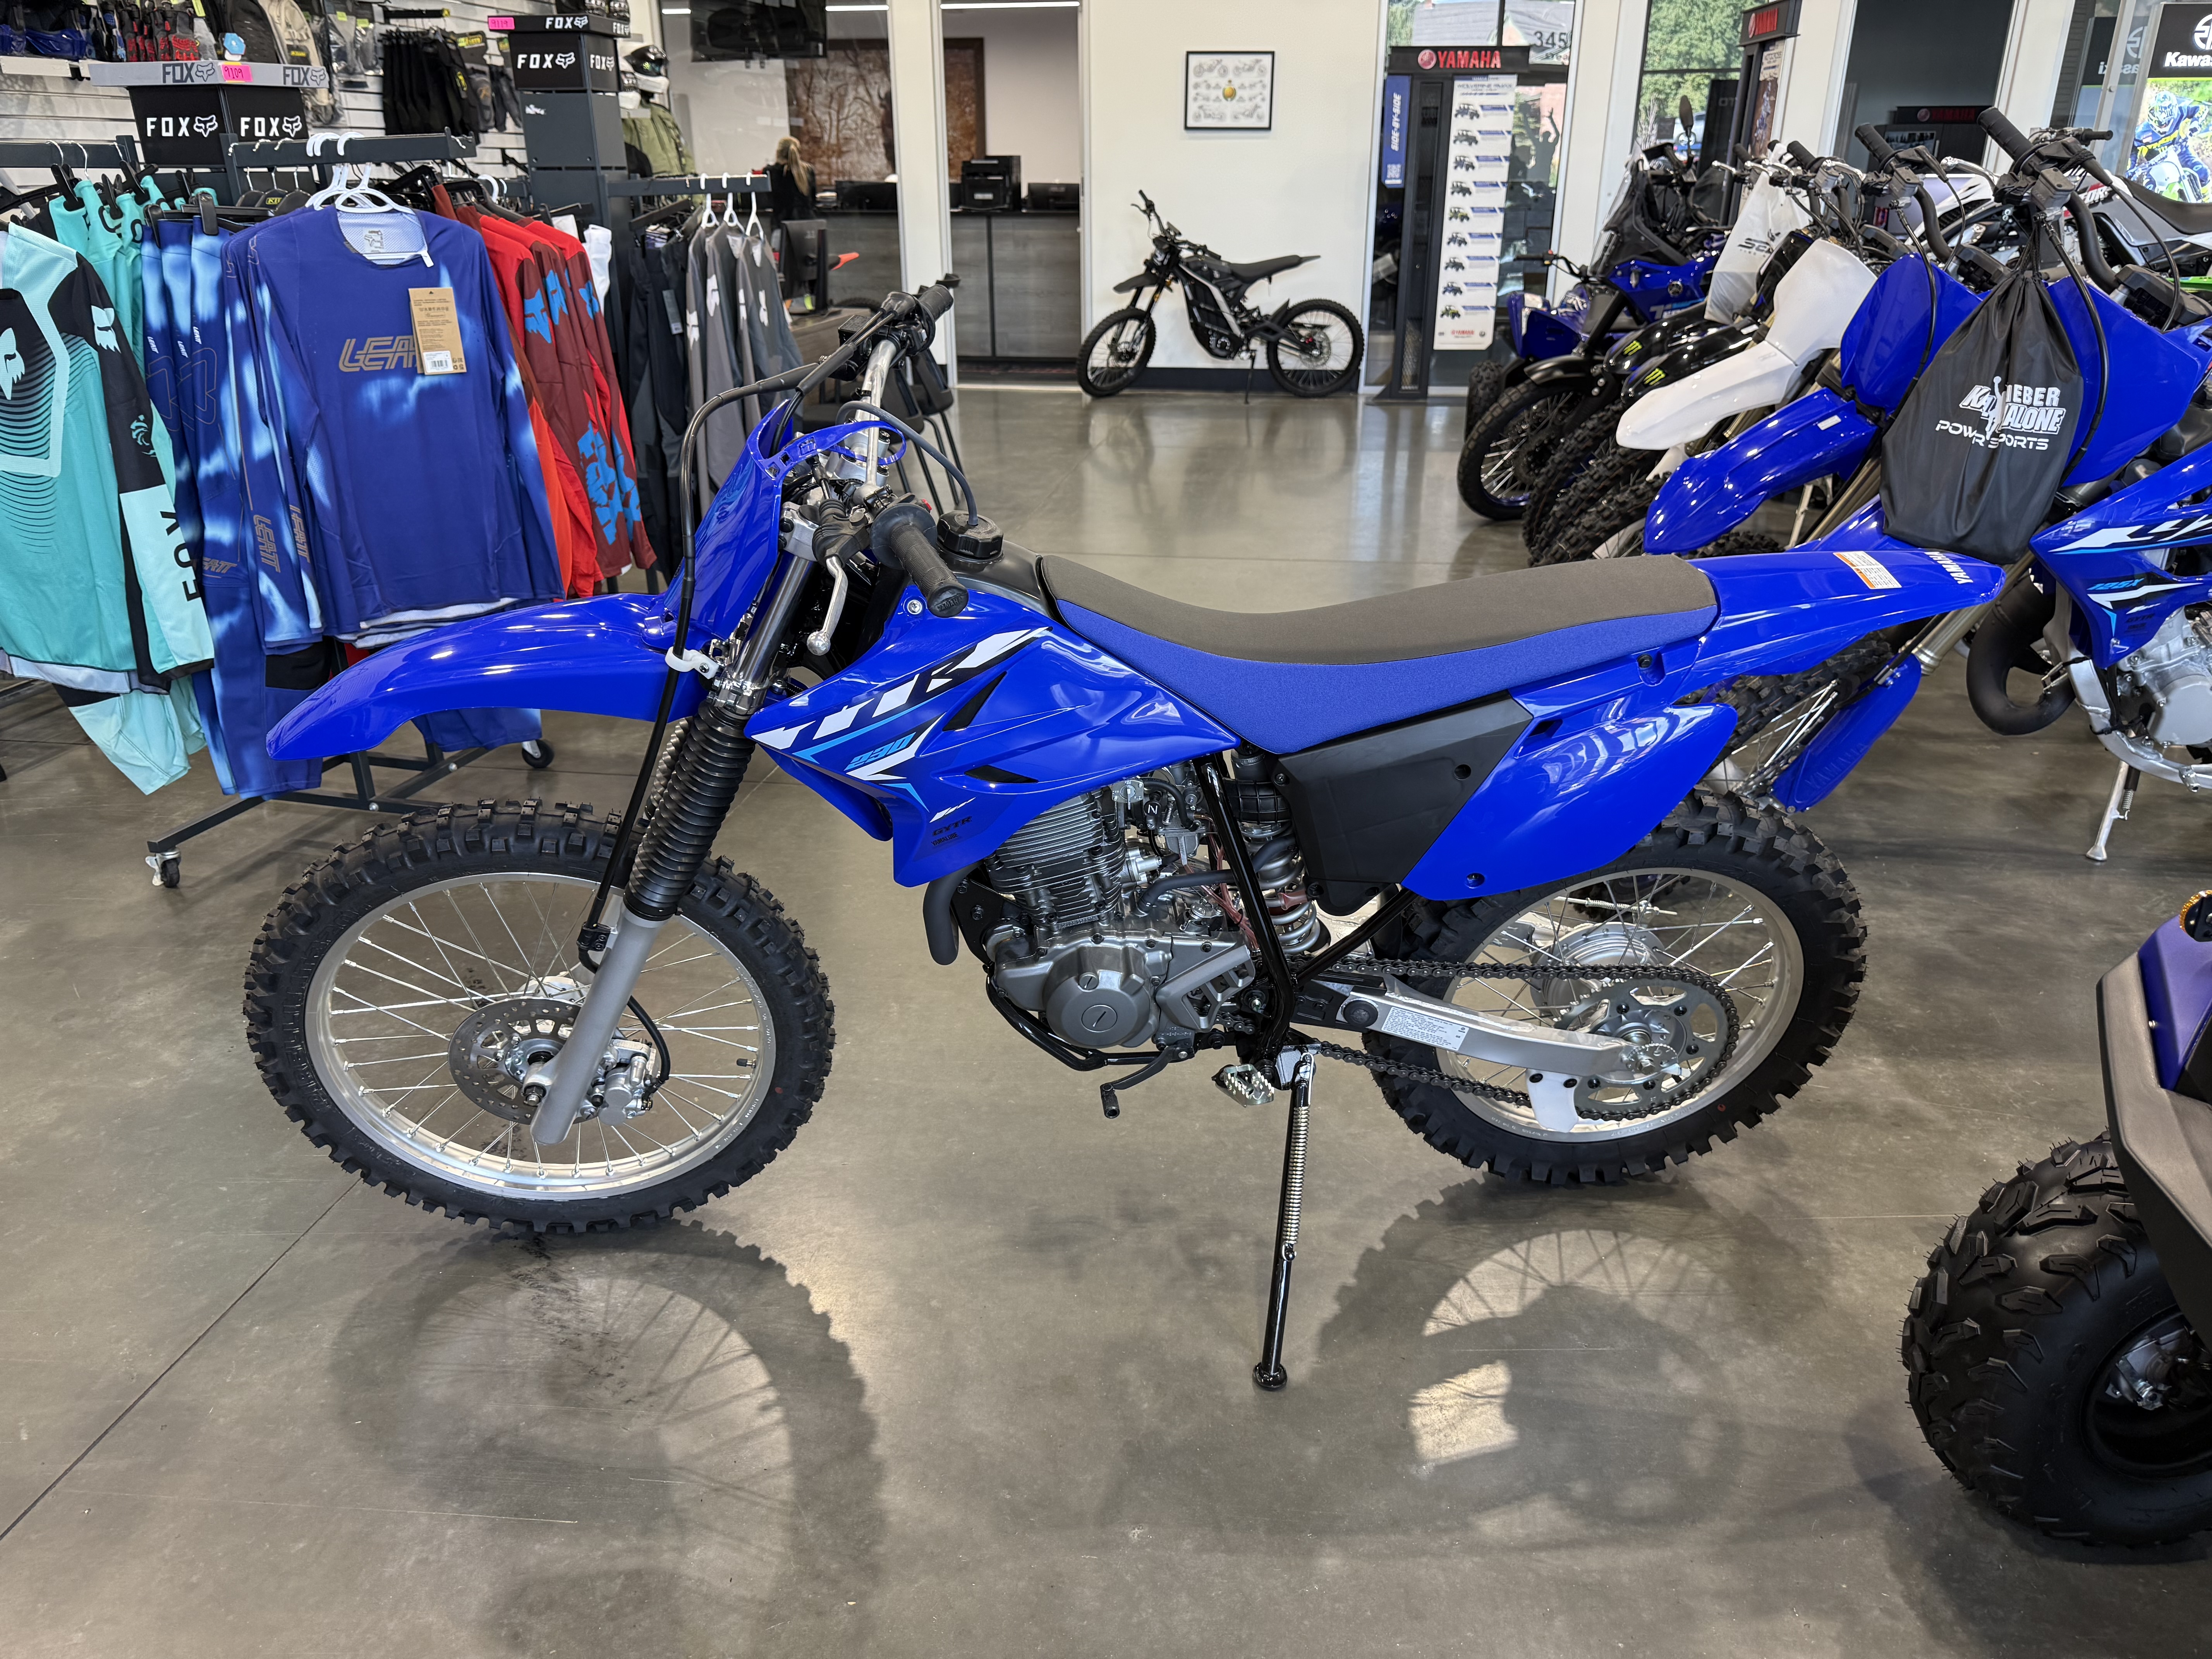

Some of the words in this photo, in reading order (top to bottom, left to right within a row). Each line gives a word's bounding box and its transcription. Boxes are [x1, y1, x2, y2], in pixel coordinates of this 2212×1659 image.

[545, 17, 573, 29] FOX
[613, 22, 624, 35] FOX
[1534, 31, 1566, 48] 345
[517, 54, 554, 69] FOX
[590, 54, 606, 70] FOX
[1437, 50, 1501, 69] YAMAHA
[162, 63, 194, 83] FOX
[224, 66, 244, 80] 9109
[283, 66, 310, 85] FOX
[147, 117, 190, 137] FOX
[240, 117, 280, 137] FOX
[1391, 93, 1401, 151] SIDE-BY-SIDE
[147, 336, 159, 354] LEATT
[193, 326, 202, 345] LEATT
[177, 341, 189, 358] LEATT
[339, 335, 417, 372] LEA
[2001, 403, 2066, 434] ALONE
[254, 514, 281, 573] LEATT
[203, 557, 237, 574] EATT
[1924, 551, 1973, 584] YAMAHA
[2086, 578, 2145, 590] 125X
[935, 596, 963, 612] YAMAHA
[844, 732, 917, 771] 230
[933, 816, 972, 836] GYTR
[931, 832, 959, 846] YAMALUBE
